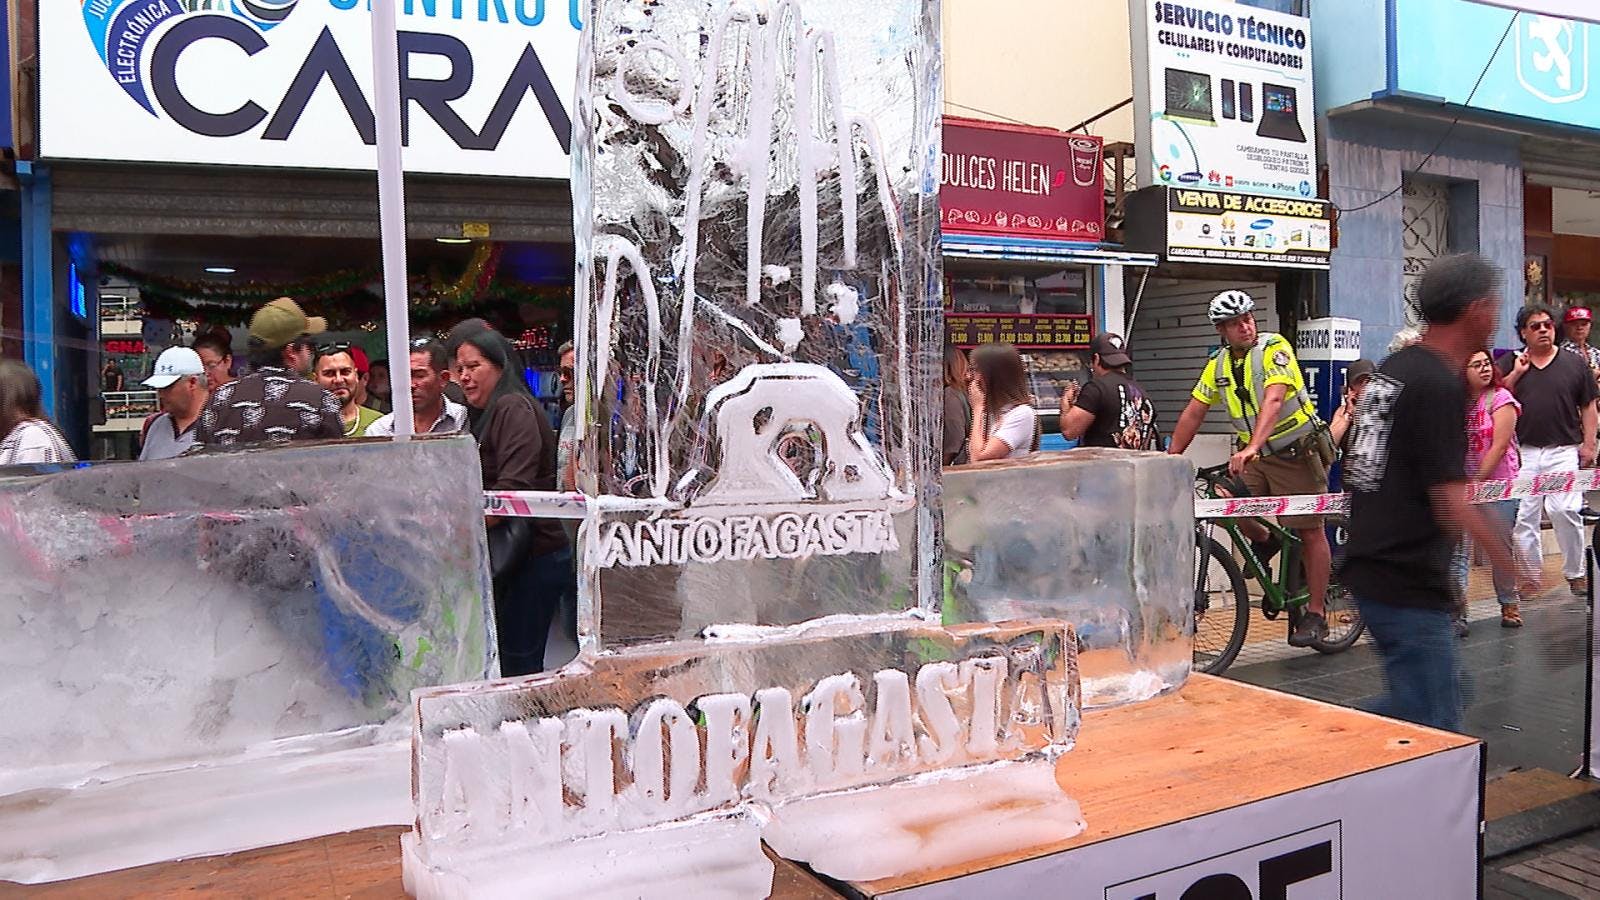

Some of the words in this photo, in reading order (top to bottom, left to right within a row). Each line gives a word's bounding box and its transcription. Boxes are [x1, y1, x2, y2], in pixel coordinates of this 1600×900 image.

[117, 0, 172, 84] ELECTRÓNICA
[1155, 1, 1233, 35] SERVICIO
[1237, 15, 1306, 50] TÉCNICO
[1158, 30, 1214, 53] CELULARES
[1217, 43, 1224, 55] Y
[1226, 43, 1303, 69] COMPUTADORES
[941, 153, 996, 190] DULCES
[1002, 160, 1050, 196] HELEN
[1176, 190, 1221, 208] VENTA
[1223, 195, 1242, 210] DE
[1244, 197, 1323, 218] ACCESORIOS
[1297, 329, 1329, 349] SERVICIO
[1334, 329, 1360, 349] SERVICIO
[599, 511, 900, 567] ANTOFAGASTA
[433, 645, 1055, 833] ANTOFAGASTA
